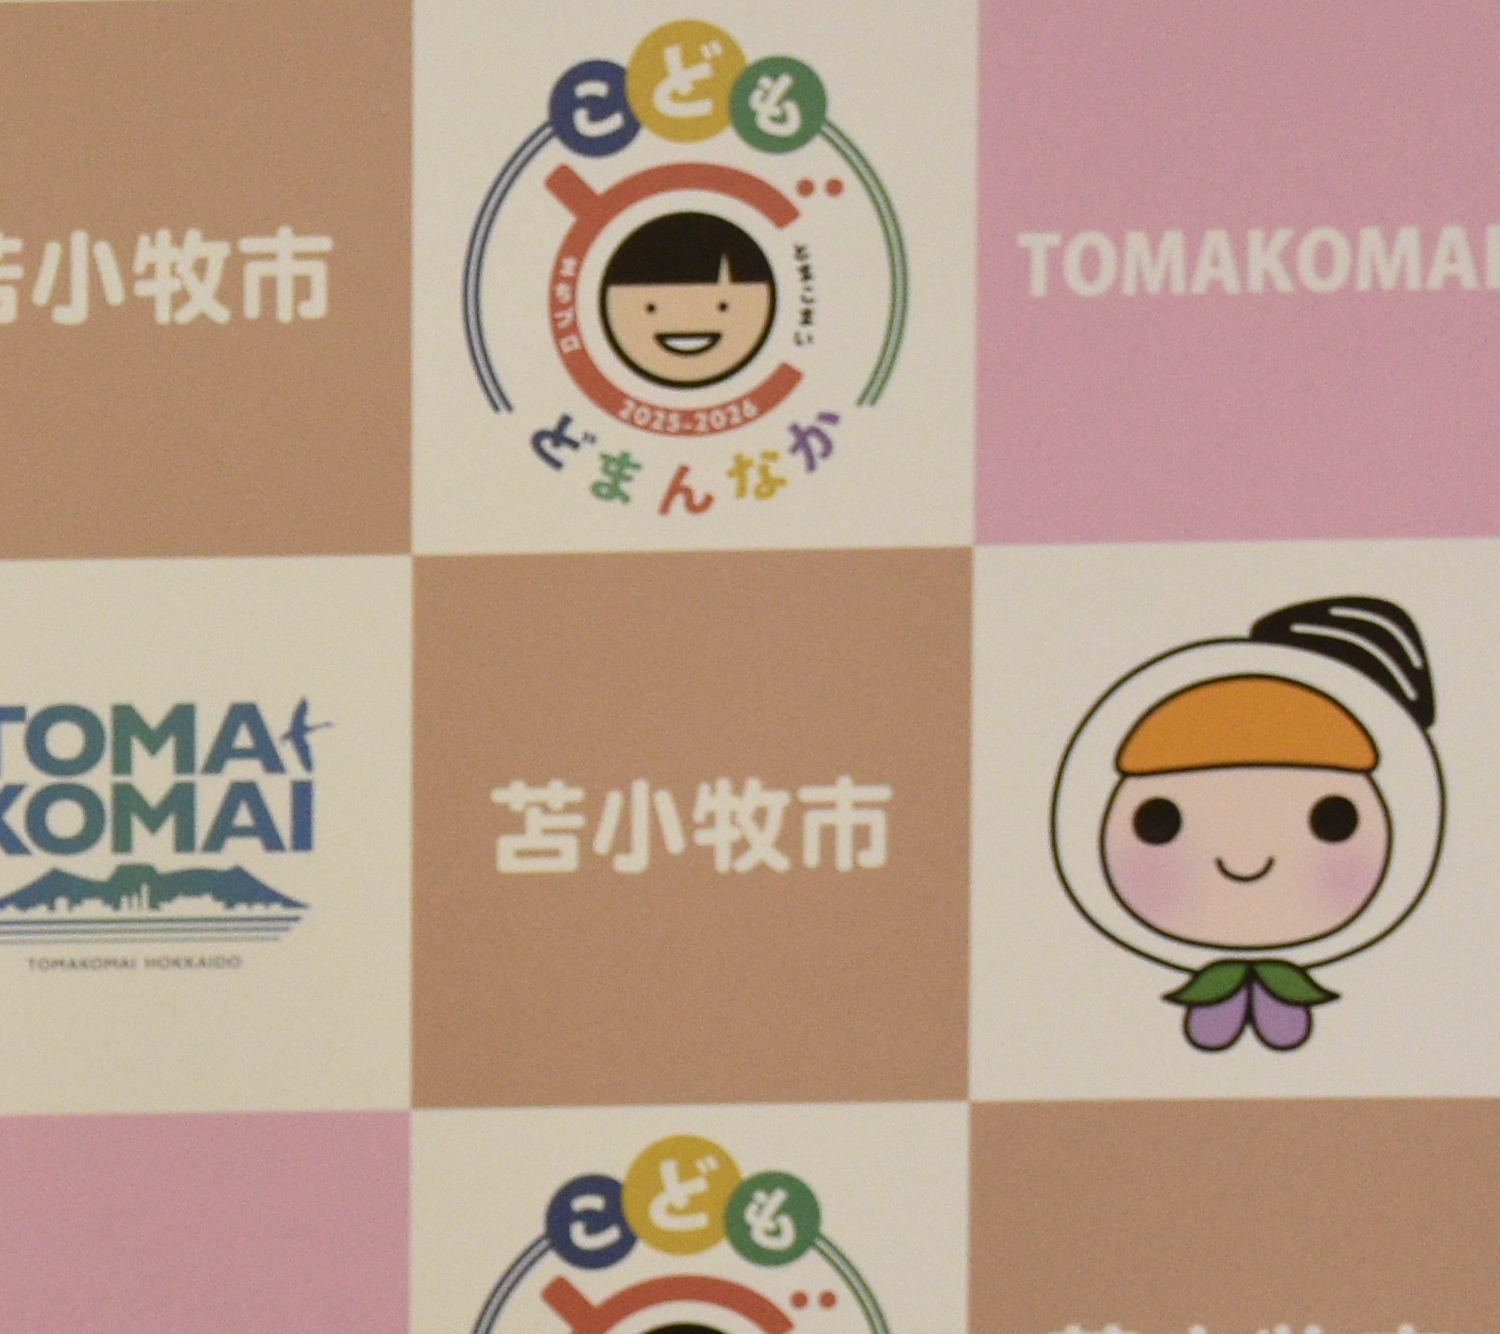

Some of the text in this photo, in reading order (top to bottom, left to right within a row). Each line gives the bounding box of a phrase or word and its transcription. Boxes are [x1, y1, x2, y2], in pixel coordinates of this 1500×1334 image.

[573, 40, 803, 136] こども
[529, 411, 839, 516] どまんなか
[617, 397, 759, 434] 2025-2026
[490, 776, 893, 874] 苫小牧市
[570, 1155, 797, 1249] こども
